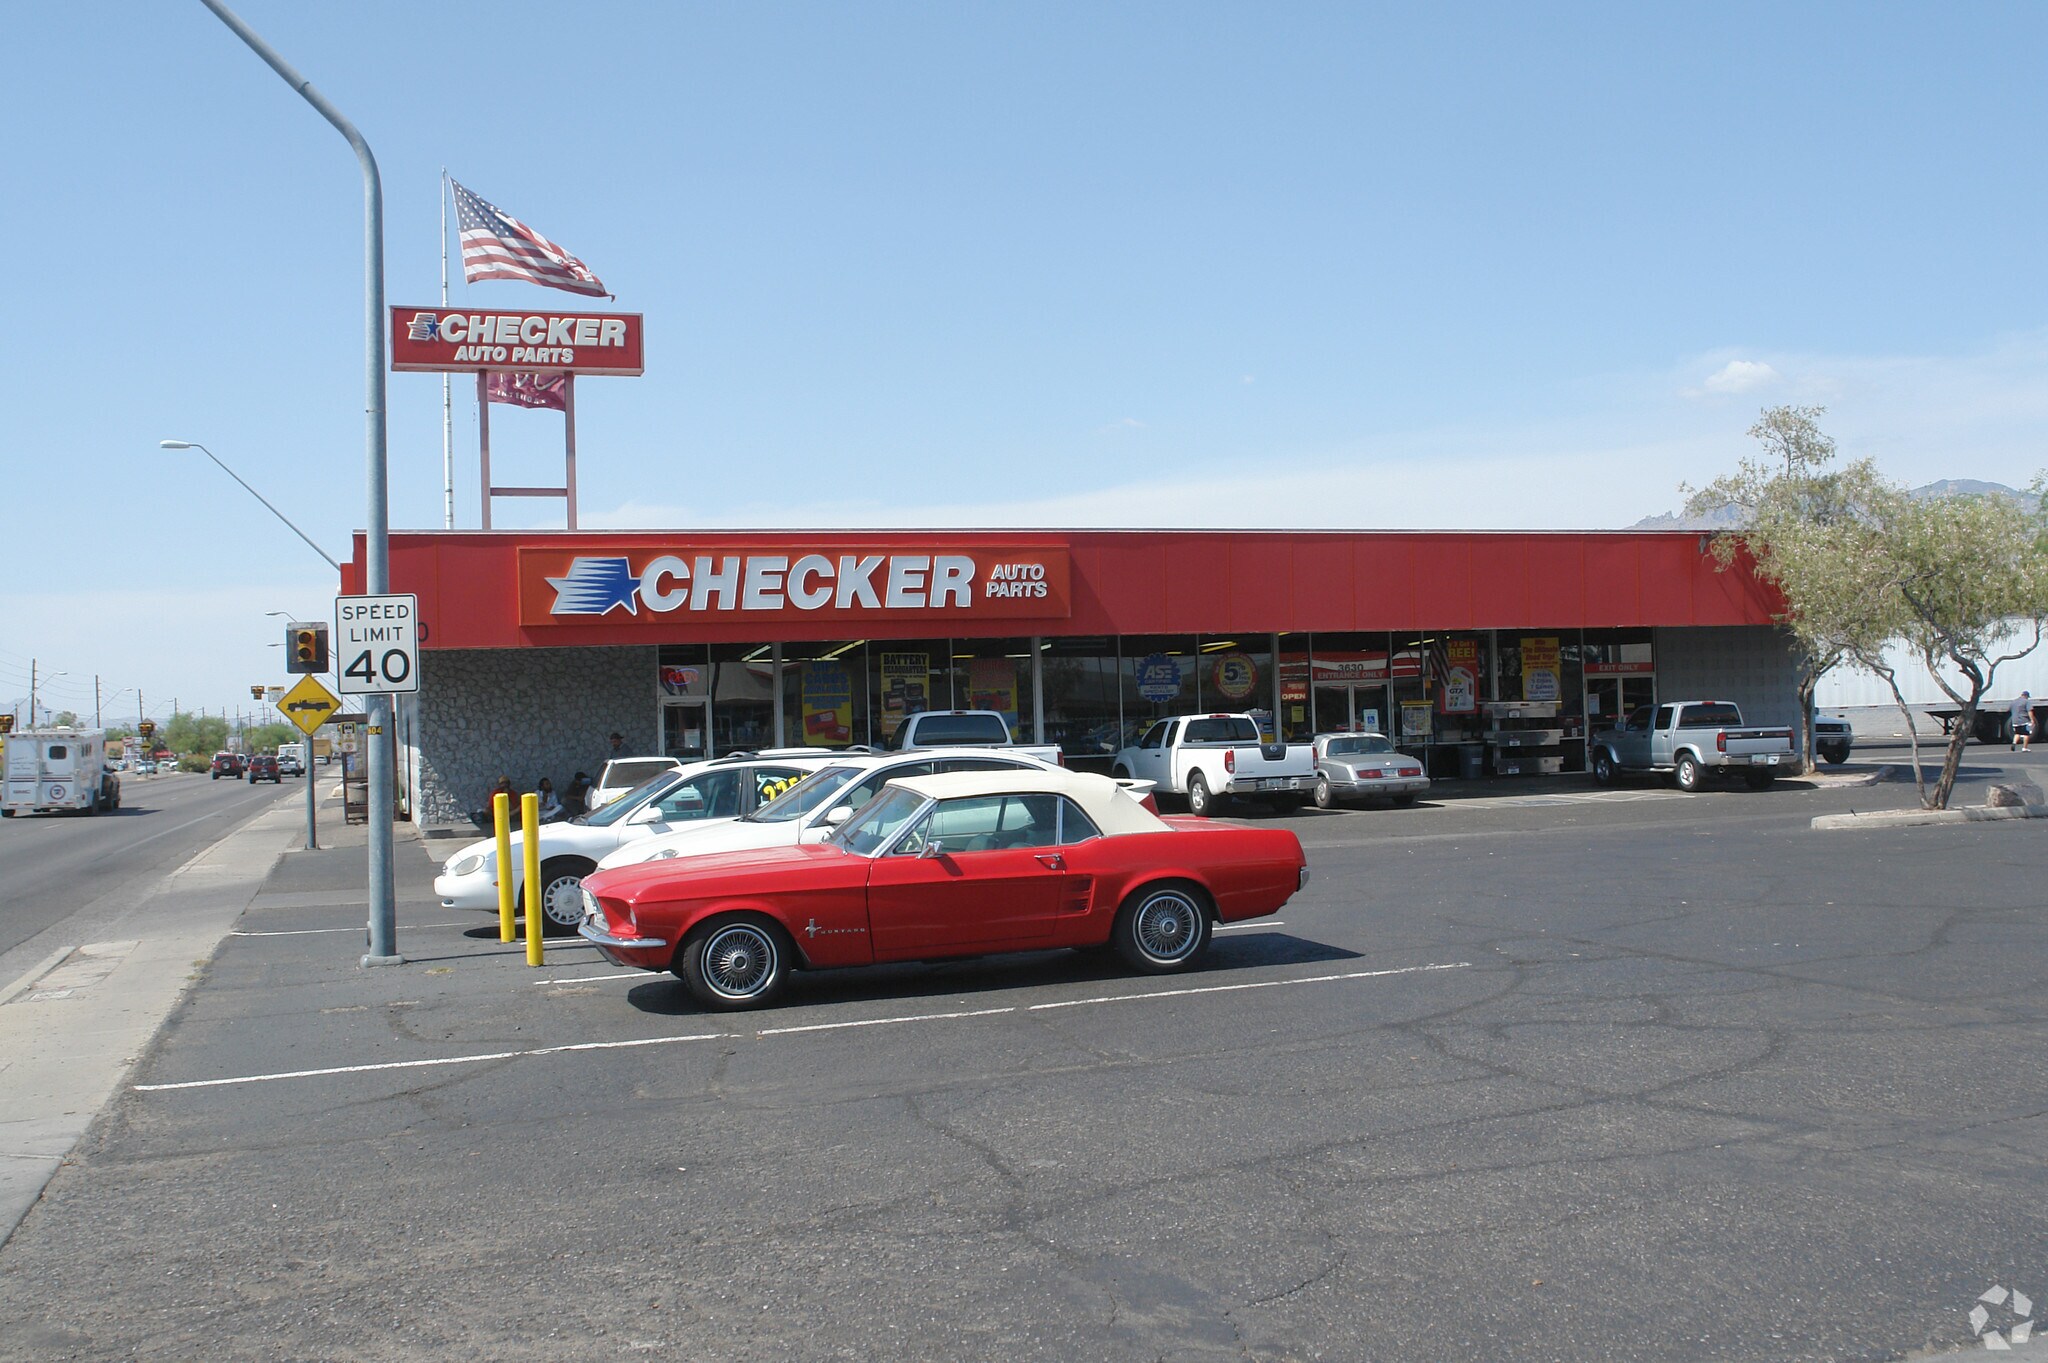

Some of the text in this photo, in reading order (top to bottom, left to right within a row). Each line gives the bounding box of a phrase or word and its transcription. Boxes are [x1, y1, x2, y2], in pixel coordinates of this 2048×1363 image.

[440, 314, 627, 347] CHECKER
[454, 346, 574, 364] AUTO PARTS
[990, 563, 1045, 580] AUTO
[640, 554, 976, 612] CHECKER
[985, 581, 1048, 598] PARTS
[342, 604, 409, 620] SPEED
[350, 626, 404, 642] LIMIT
[883, 654, 927, 665] BATTERY
[1448, 647, 1475, 657] REE!
[344, 648, 411, 684] 40
[1144, 664, 1172, 679] ASE
[1338, 663, 1364, 672] 3630
[1619, 663, 1640, 671] ONLY
[1317, 671, 1384, 680] ENTRANCE ONLY
[1282, 692, 1306, 700] OPEN
